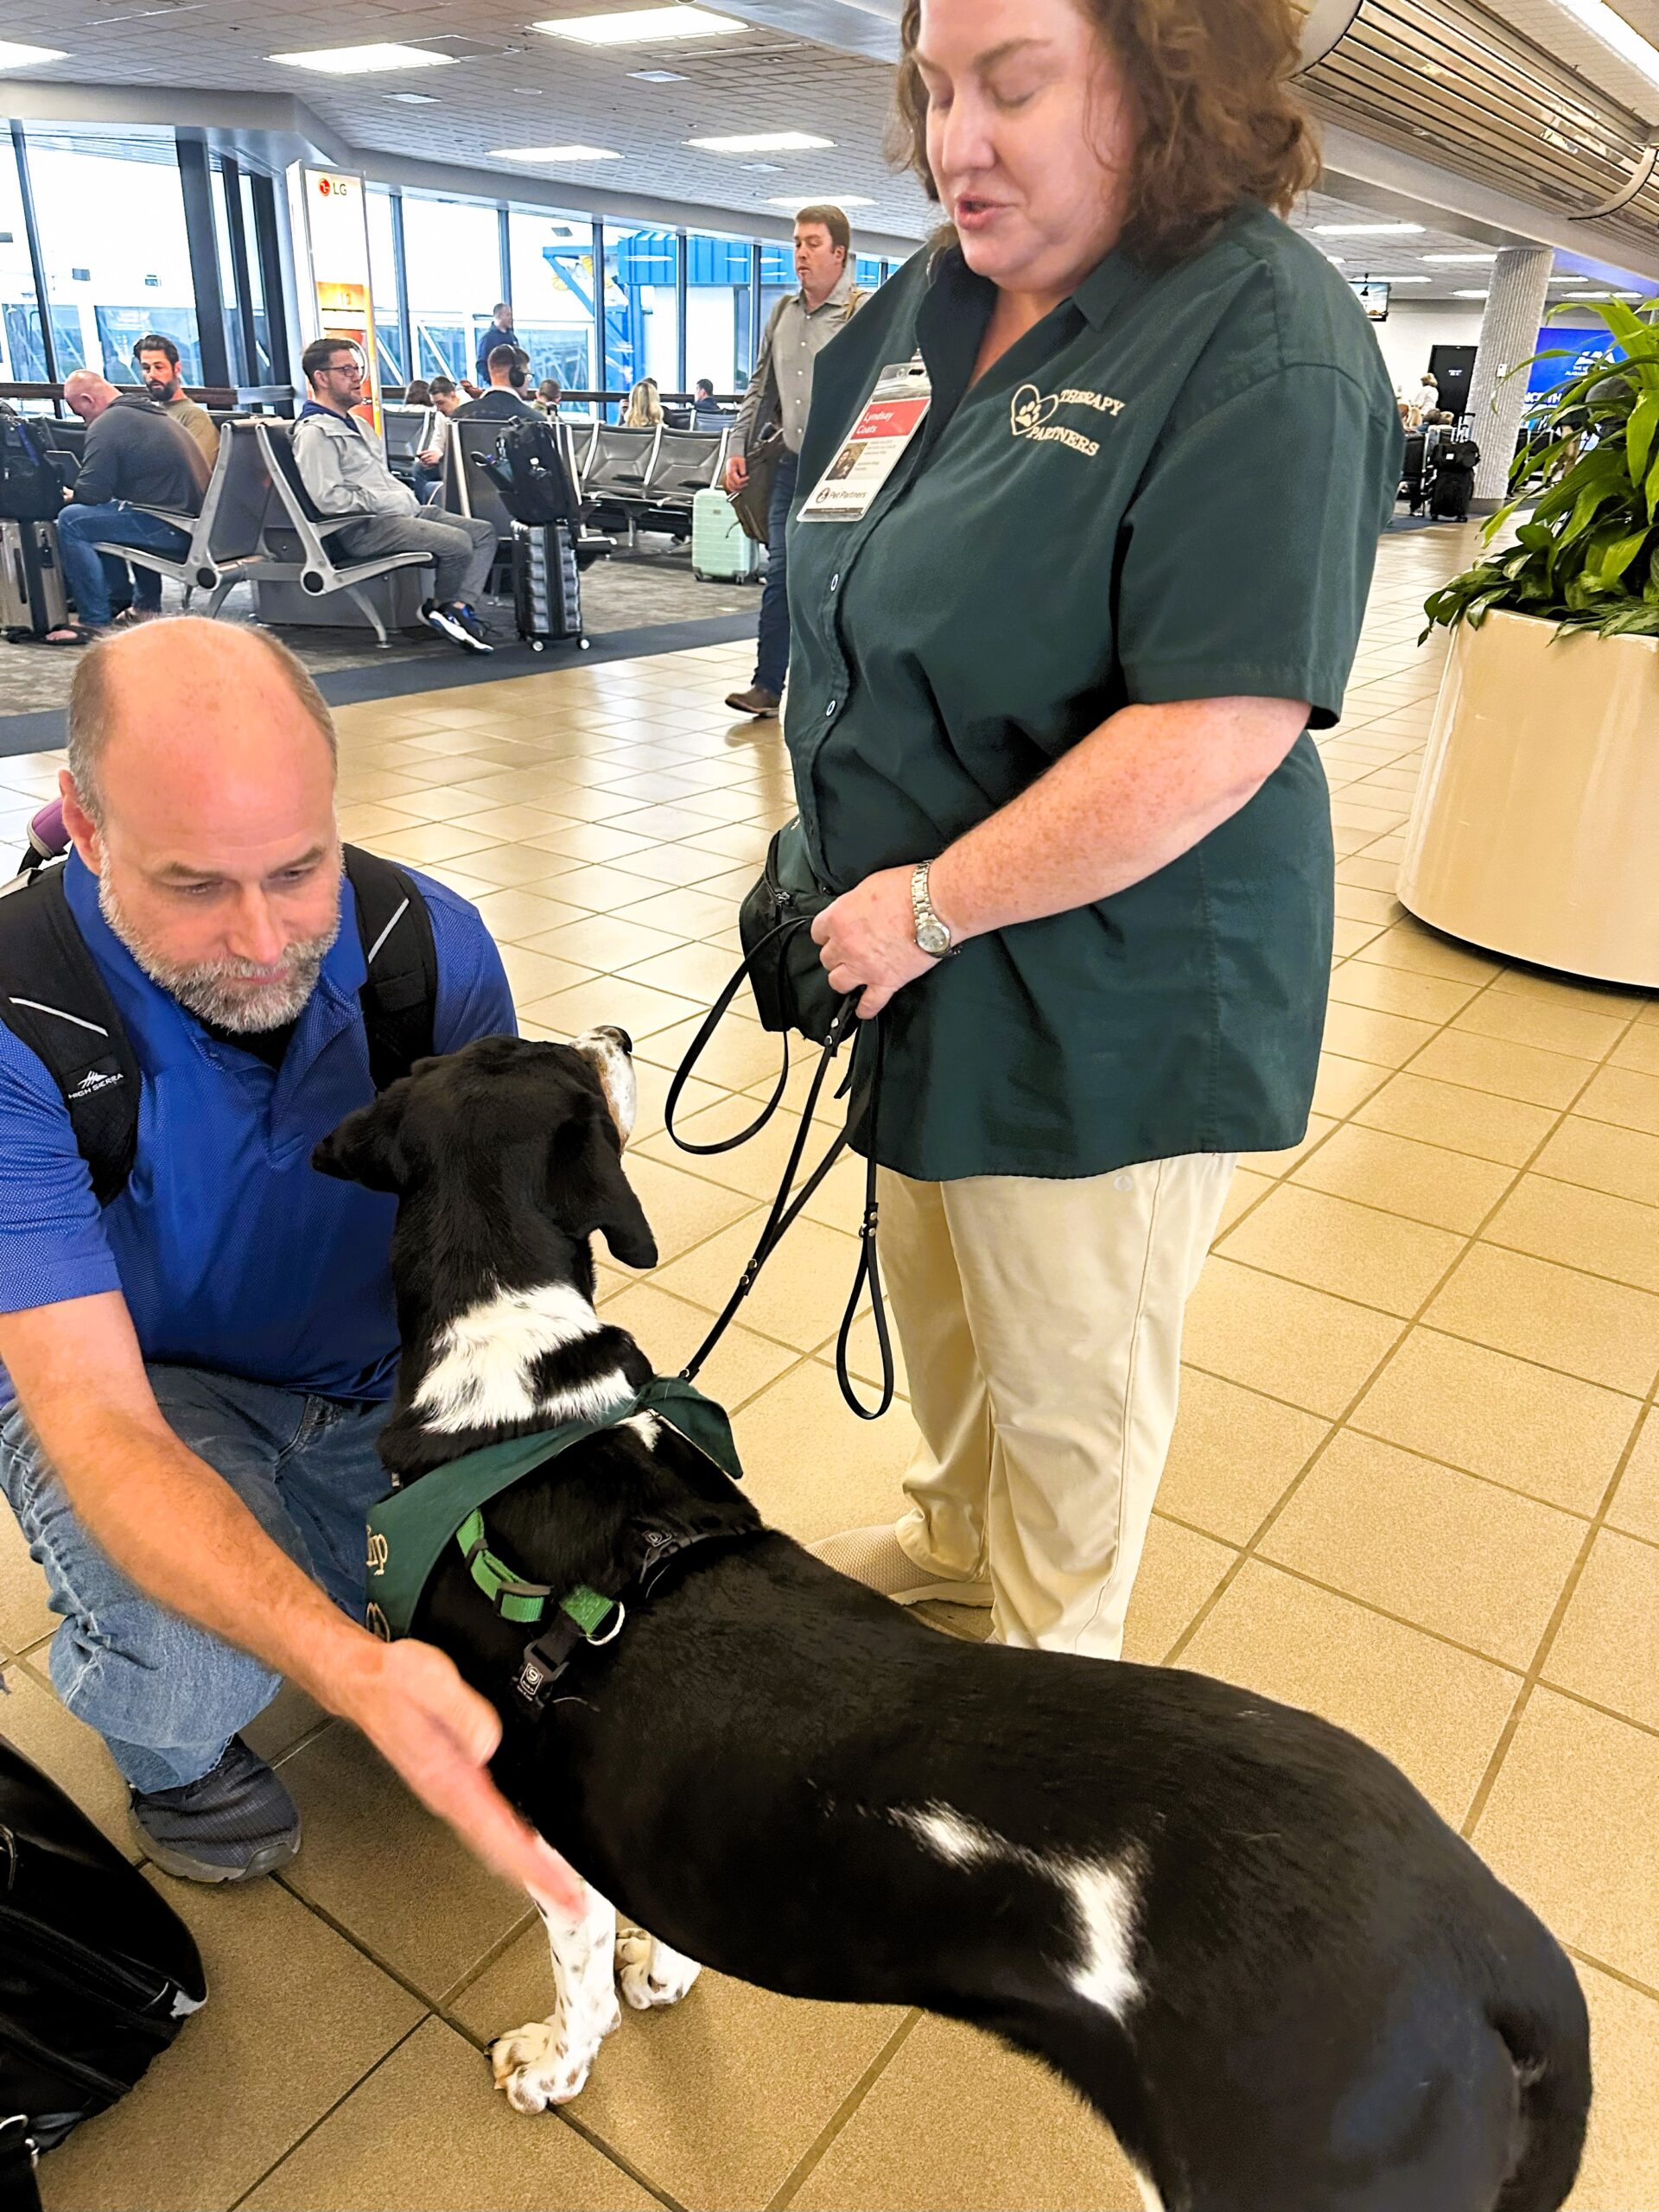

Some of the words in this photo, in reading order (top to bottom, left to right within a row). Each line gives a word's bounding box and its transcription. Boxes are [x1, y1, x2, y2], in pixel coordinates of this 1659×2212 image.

[333, 182, 347, 196] LG
[1058, 389, 1126, 416] THERAPY
[863, 411, 895, 423] Lyndsay
[856, 424, 878, 435] Coats
[1026, 426, 1100, 456] PARTNERS
[841, 491, 868, 499] Partners
[68, 1088, 92, 1099] HIGH
[92, 1073, 124, 1091] SIERRA
